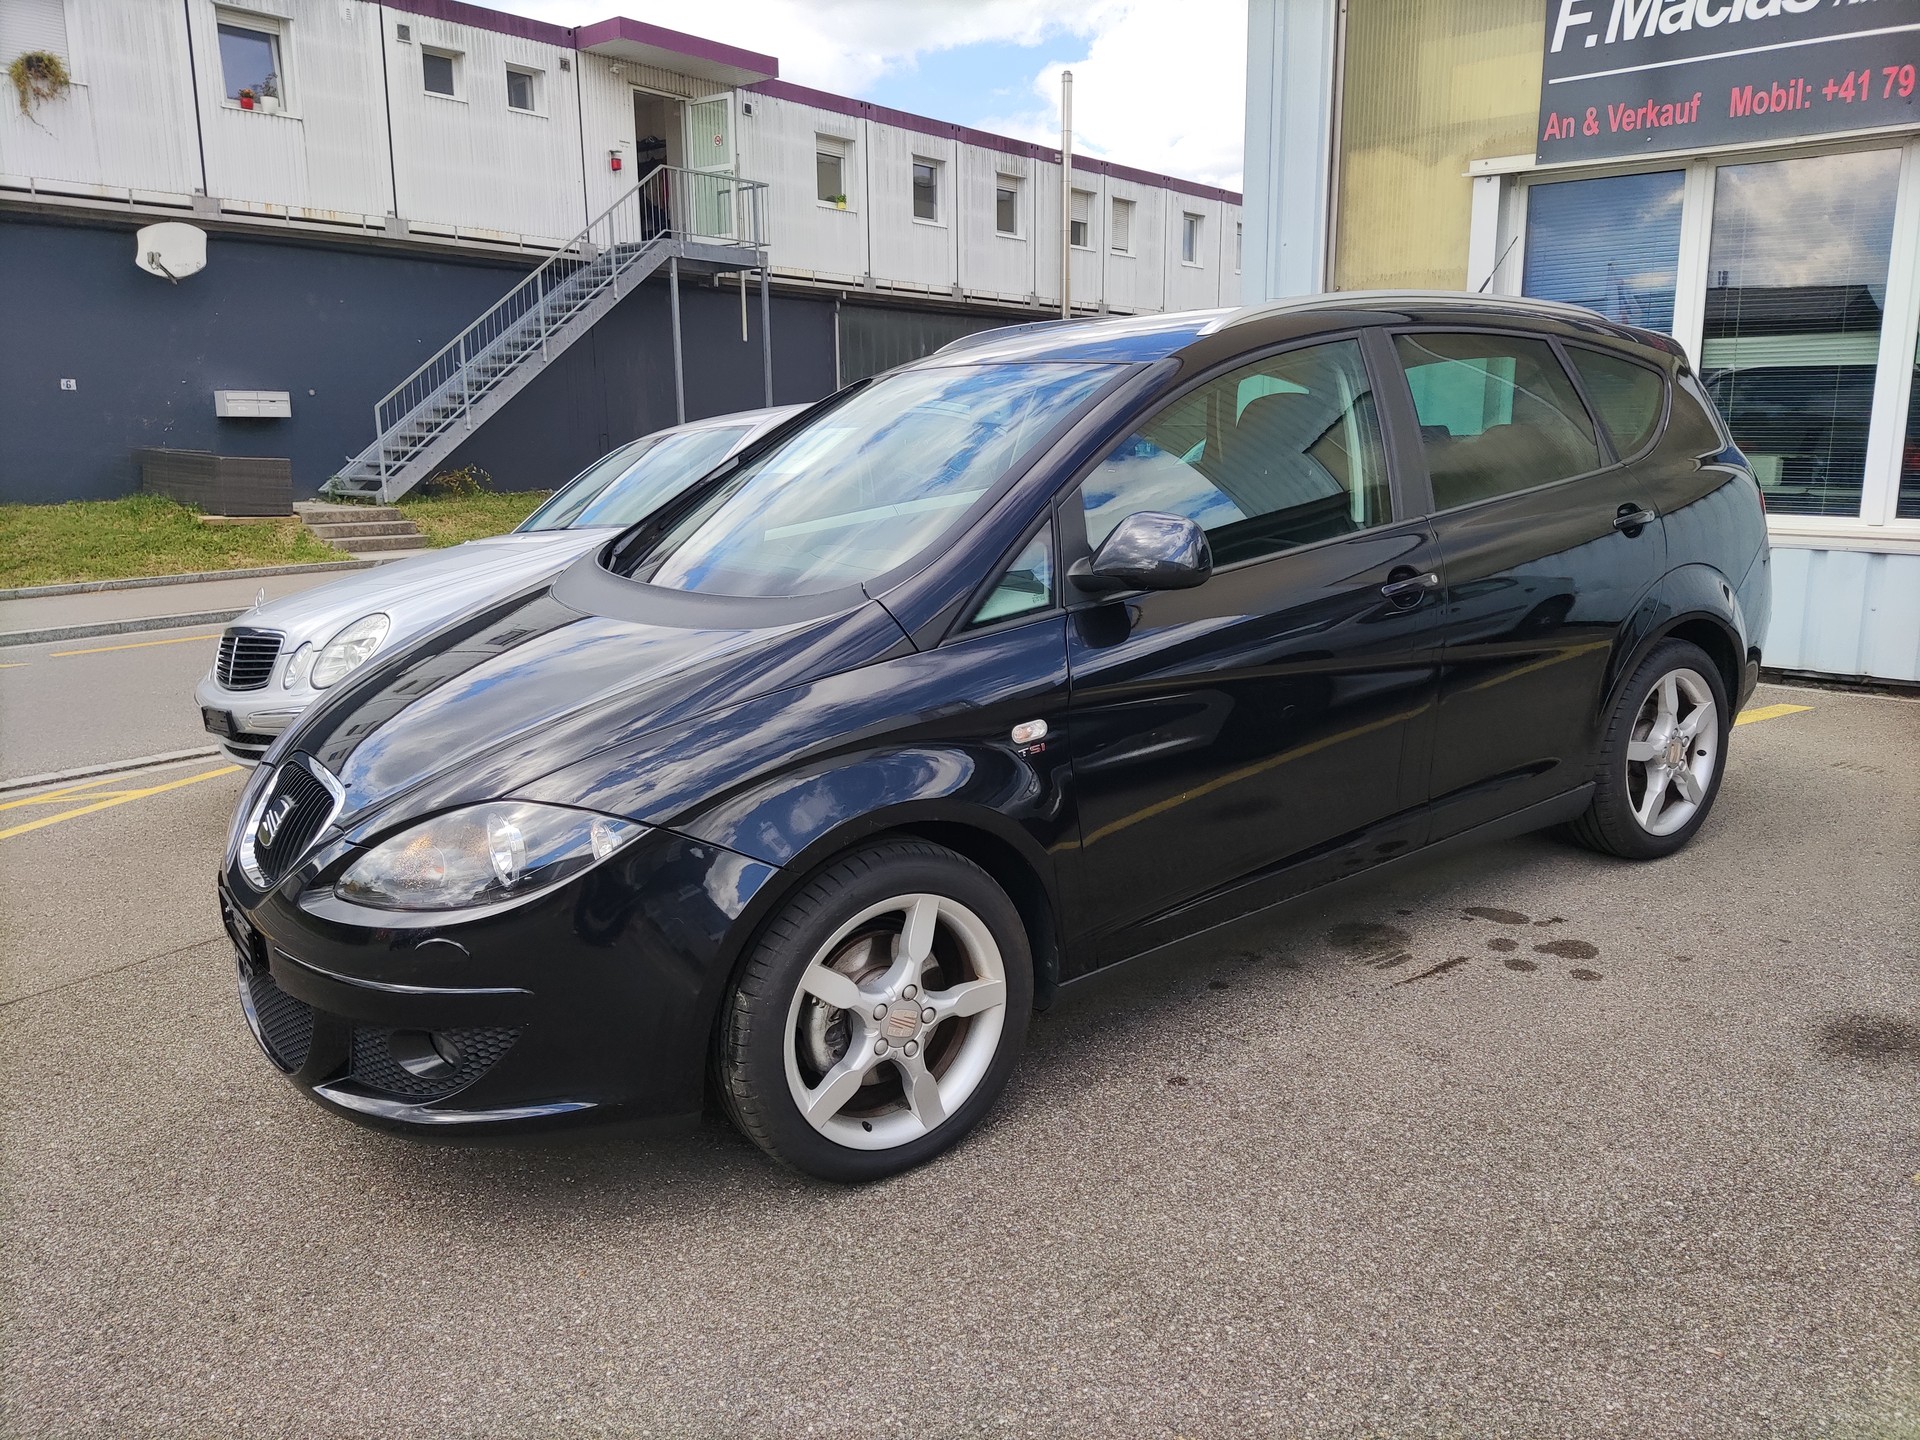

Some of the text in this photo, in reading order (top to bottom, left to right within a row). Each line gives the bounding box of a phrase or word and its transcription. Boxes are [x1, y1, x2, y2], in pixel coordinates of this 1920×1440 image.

[1543, 64, 1916, 141] An & Verkauf Mobil: +41 79
[1018, 742, 1046, 757] TSI
